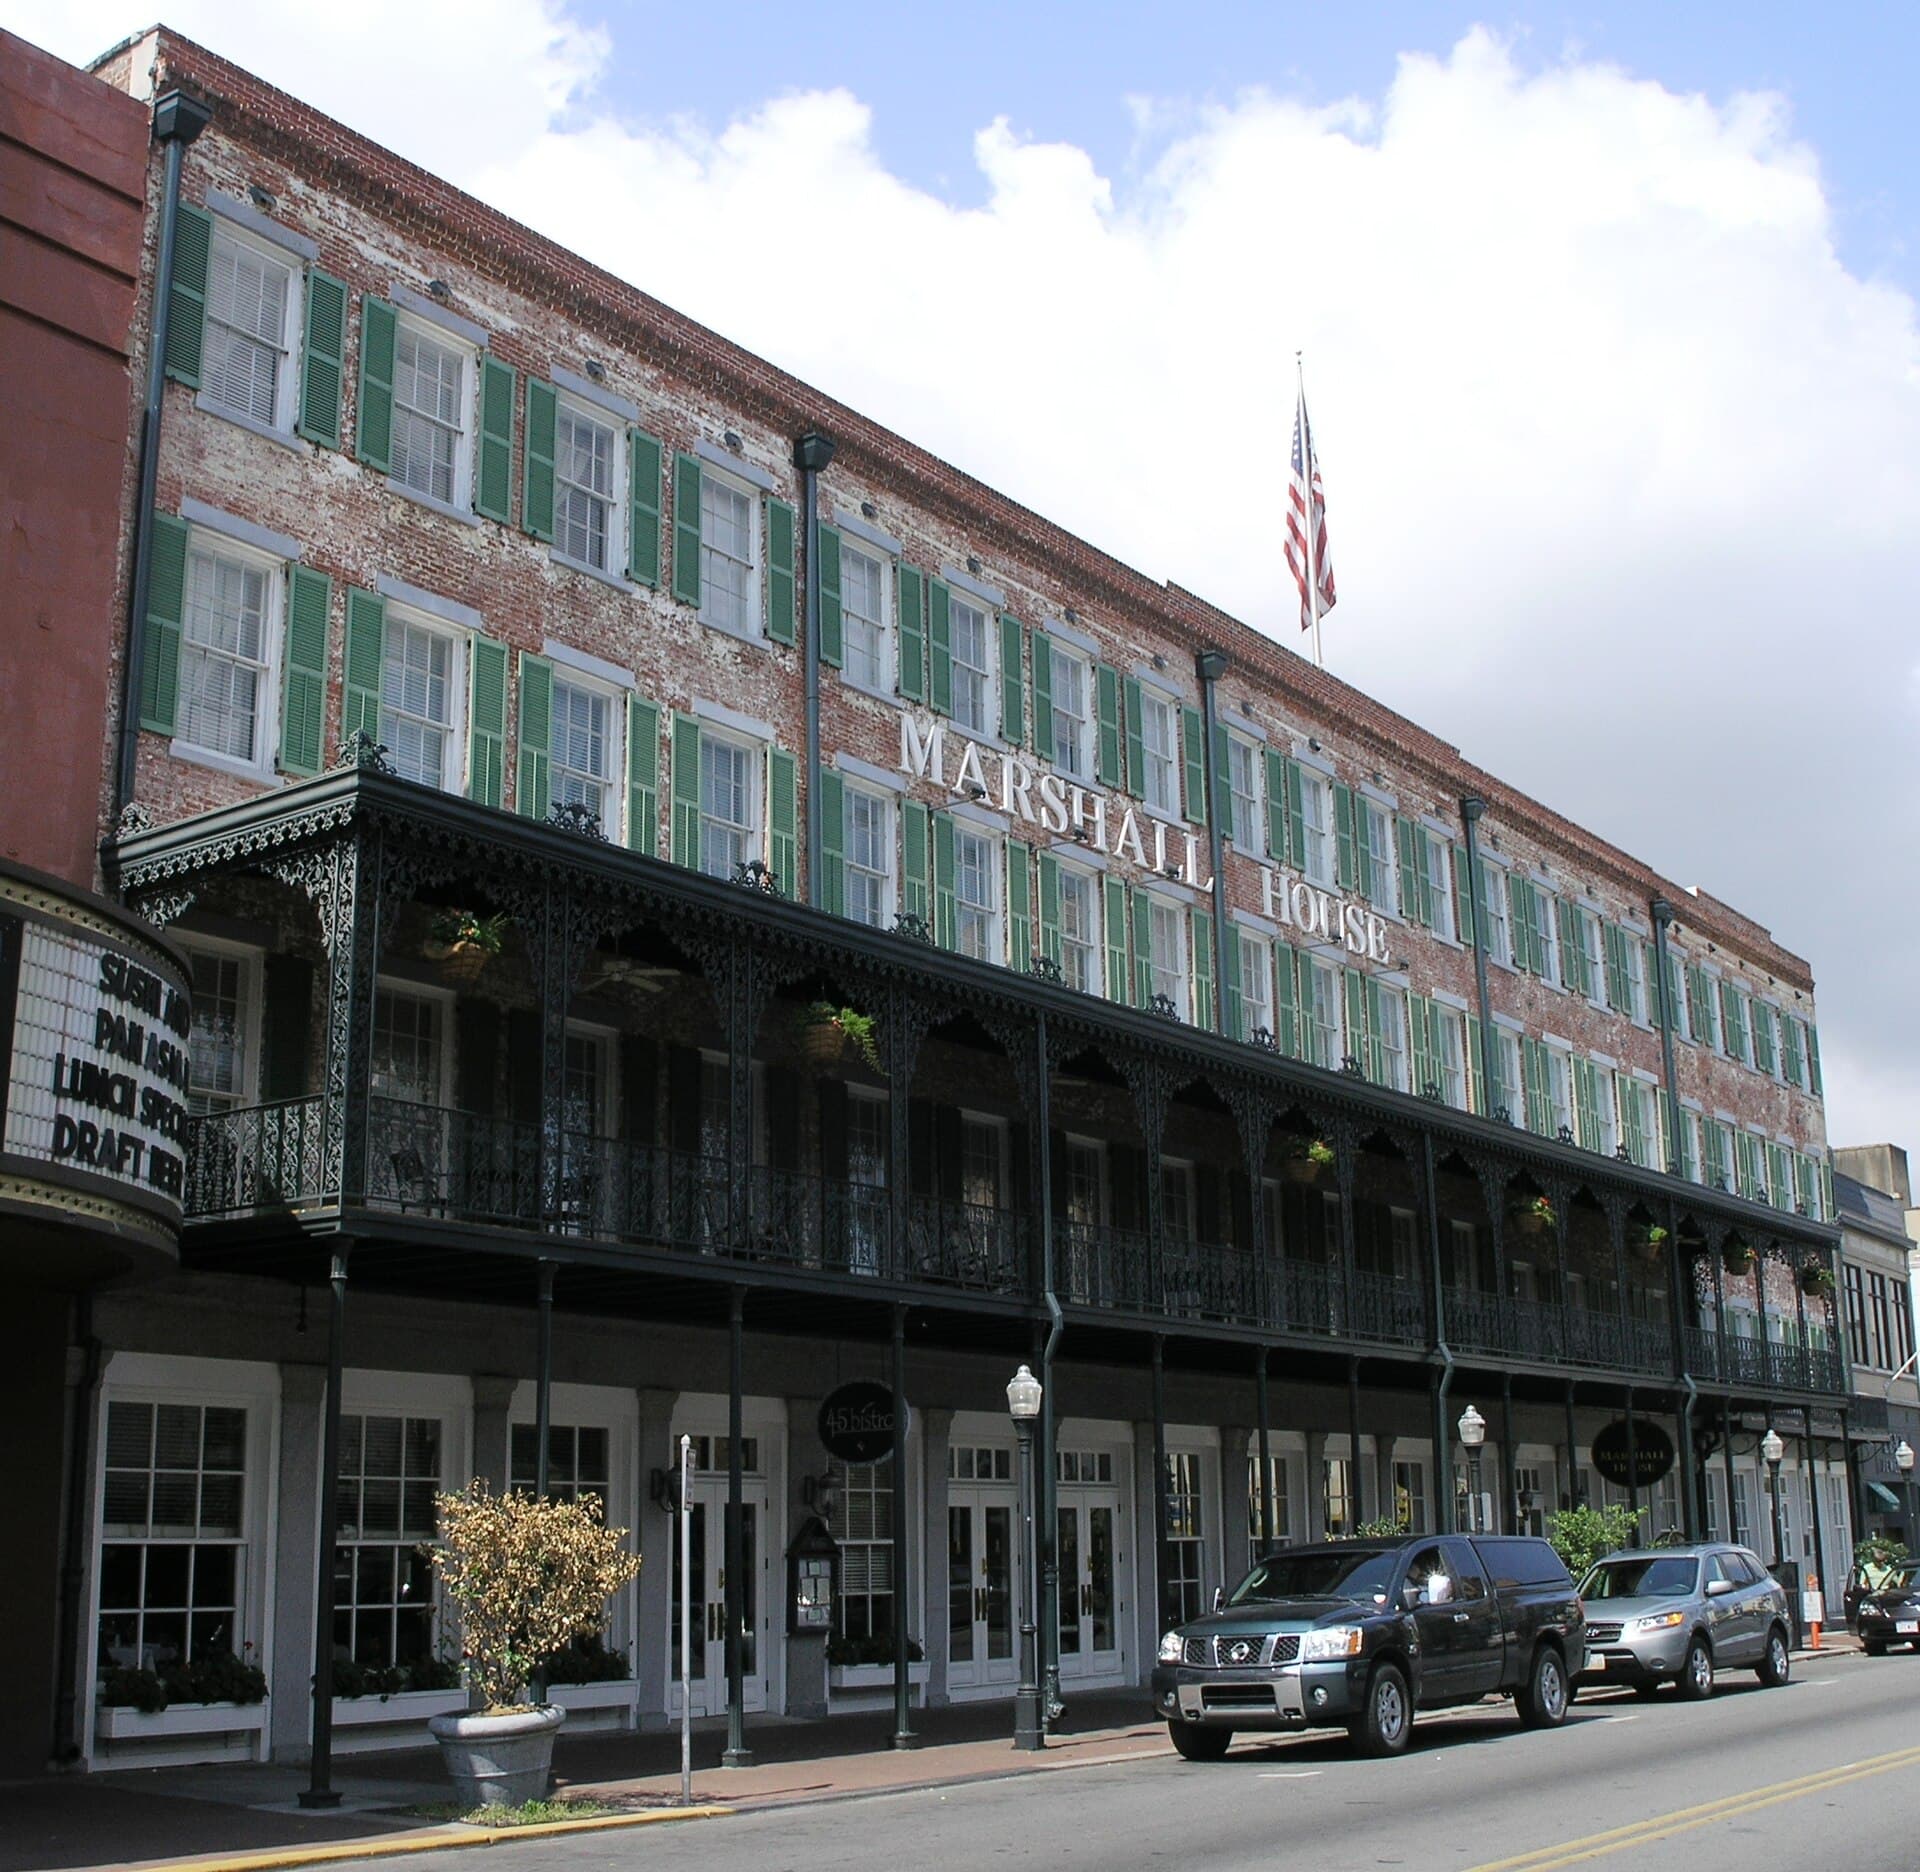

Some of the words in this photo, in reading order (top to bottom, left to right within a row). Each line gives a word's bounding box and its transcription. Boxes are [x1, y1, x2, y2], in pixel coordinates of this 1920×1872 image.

[899, 711, 1213, 893] MARSHALL
[1261, 866, 1389, 964] HOUSE
[101, 953, 161, 1018] SUSHI
[96, 1007, 143, 1066] PAN
[53, 1053, 137, 1120] LUNCH
[54, 1113, 145, 1180] DRAFT
